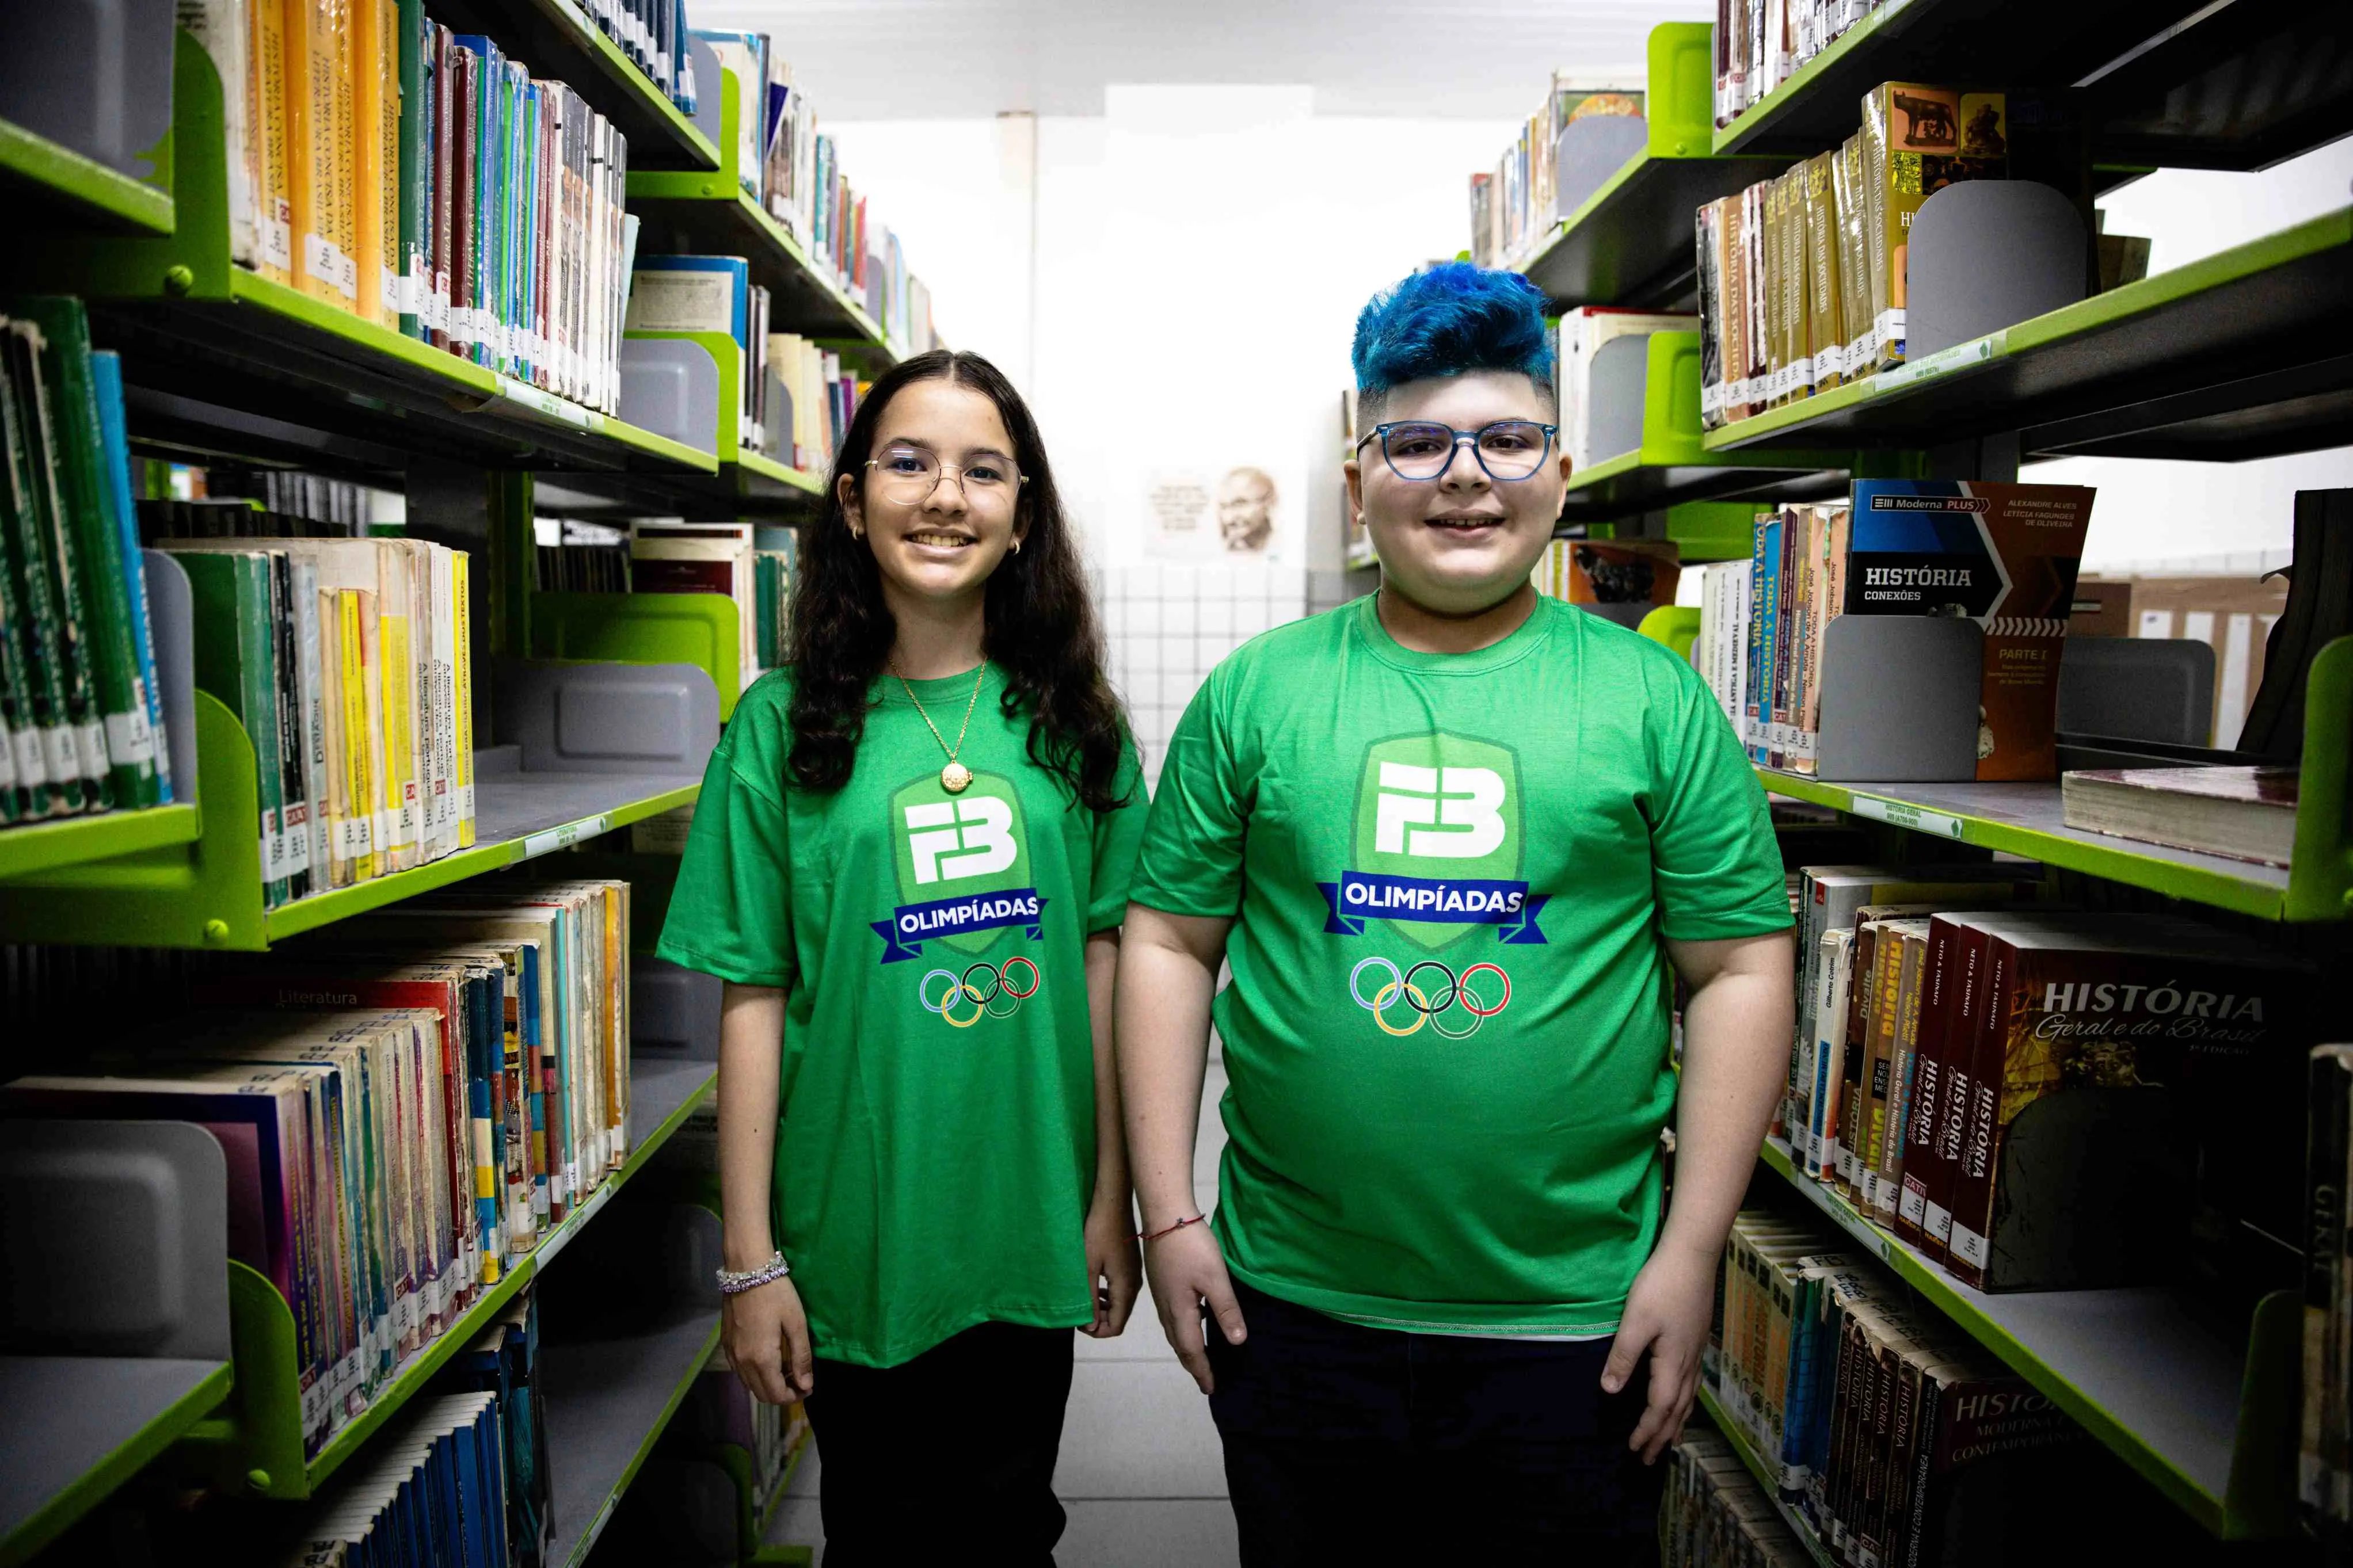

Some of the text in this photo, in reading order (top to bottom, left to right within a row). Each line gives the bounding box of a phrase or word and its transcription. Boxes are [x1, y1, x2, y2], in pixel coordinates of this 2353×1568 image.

[1729, 287, 1740, 315] DAS
[1896, 499, 1975, 510] Moderna PLUS
[2008, 499, 2077, 510] ALEXANDRE ALVES
[2034, 512, 2076, 521] FAGUNDES
[2037, 520, 2073, 528] OLIVEIRA
[1865, 564, 1973, 587] HISTÓRIA
[1806, 588, 1814, 617] Jobson
[1864, 589, 1921, 601] CONEXÕES
[1762, 574, 1775, 703] TODA A HISTÓRIA
[1805, 620, 1812, 631] de
[1731, 624, 1739, 666] MEDIEVAL
[1802, 644, 1810, 672] Arruda
[1999, 648, 2039, 660] PARTE
[1807, 644, 1816, 688] HISTÓRIA
[1375, 761, 1506, 859] FB
[904, 796, 1018, 885] FB
[1345, 883, 1524, 914] OLIMPÍADAS
[900, 896, 1039, 934] OLIMPÍADAS
[1968, 948, 1976, 970] NETO
[1996, 959, 2004, 982] NETO
[1860, 968, 1872, 1020] Divalte
[1915, 966, 1923, 995] Jobson
[1933, 967, 1942, 1006] TASINAFO
[279, 987, 358, 1006] Literatura
[1914, 997, 1921, 1008] de
[1962, 977, 1973, 1017] TASINAFO
[1989, 989, 2000, 1031] TASINAFO
[2043, 978, 2264, 1023] HISTÓRIA
[1902, 1018, 1911, 1041] Piletti
[1910, 1018, 1918, 1045] Arruda
[2035, 1013, 2267, 1043] Geral e do Brasil
[1895, 1049, 1906, 1078] História
[1917, 1054, 1928, 1089] Geral
[1893, 1079, 1903, 1102] Geral
[1945, 1065, 1958, 1102] Geral
[1973, 1079, 1984, 1115] Geral
[1918, 1059, 1939, 1146] HISTÓRIA
[1946, 1071, 1969, 1161] HISTÓRIA
[1889, 1108, 1900, 1139] História
[1910, 1106, 1924, 1146] Brasil
[1973, 1086, 1994, 1179] HISTÓRIA
[1887, 1139, 1897, 1149] do
[1937, 1119, 1951, 1161] Brasil
[1884, 1150, 1895, 1173] Brasil
[1965, 1134, 1978, 1178] Brasil
[1837, 1344, 1851, 1395] ISTÓRIA
[1895, 1383, 1912, 1448] HISTÓRIA
[1975, 1417, 2054, 1439] MODERNA
[1912, 1453, 1930, 1526] CONTEMPORÂNEA
